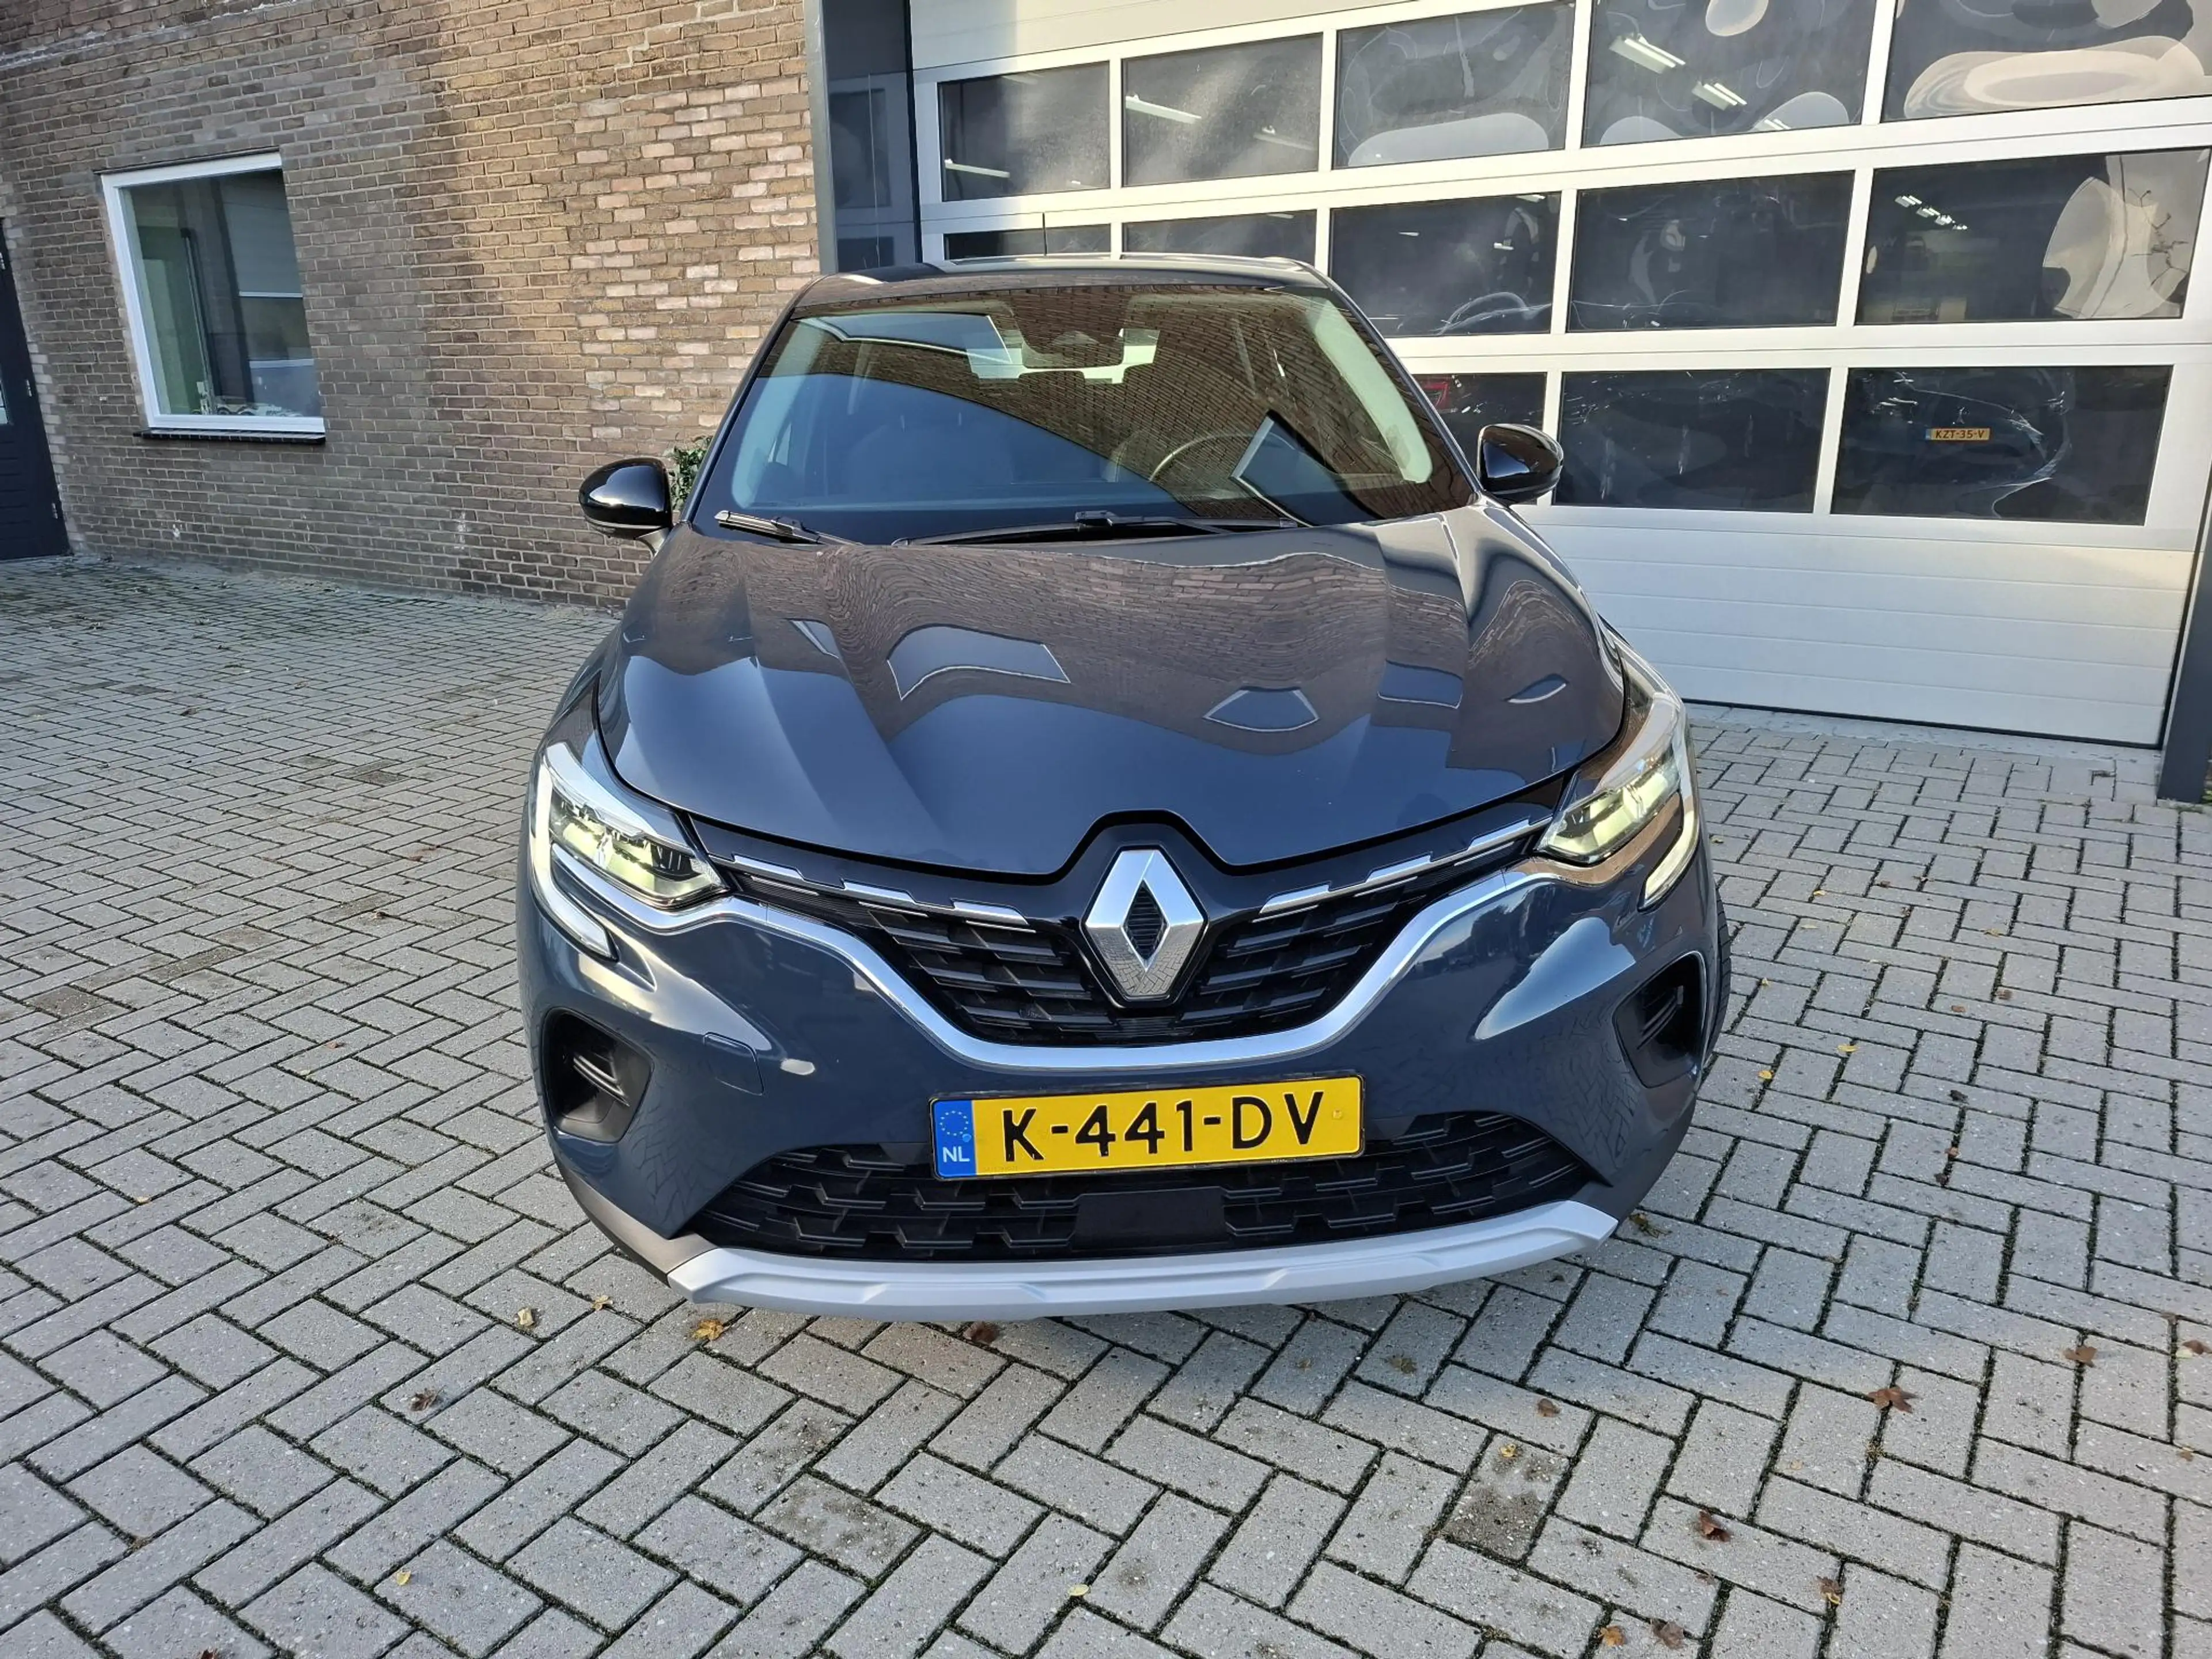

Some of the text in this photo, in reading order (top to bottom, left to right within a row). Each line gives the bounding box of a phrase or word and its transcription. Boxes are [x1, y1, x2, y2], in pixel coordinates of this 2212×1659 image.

[1936, 430, 1985, 438] KZT-35-V
[1002, 1092, 1324, 1162] K-441-DV
[942, 1146, 971, 1162] NL
